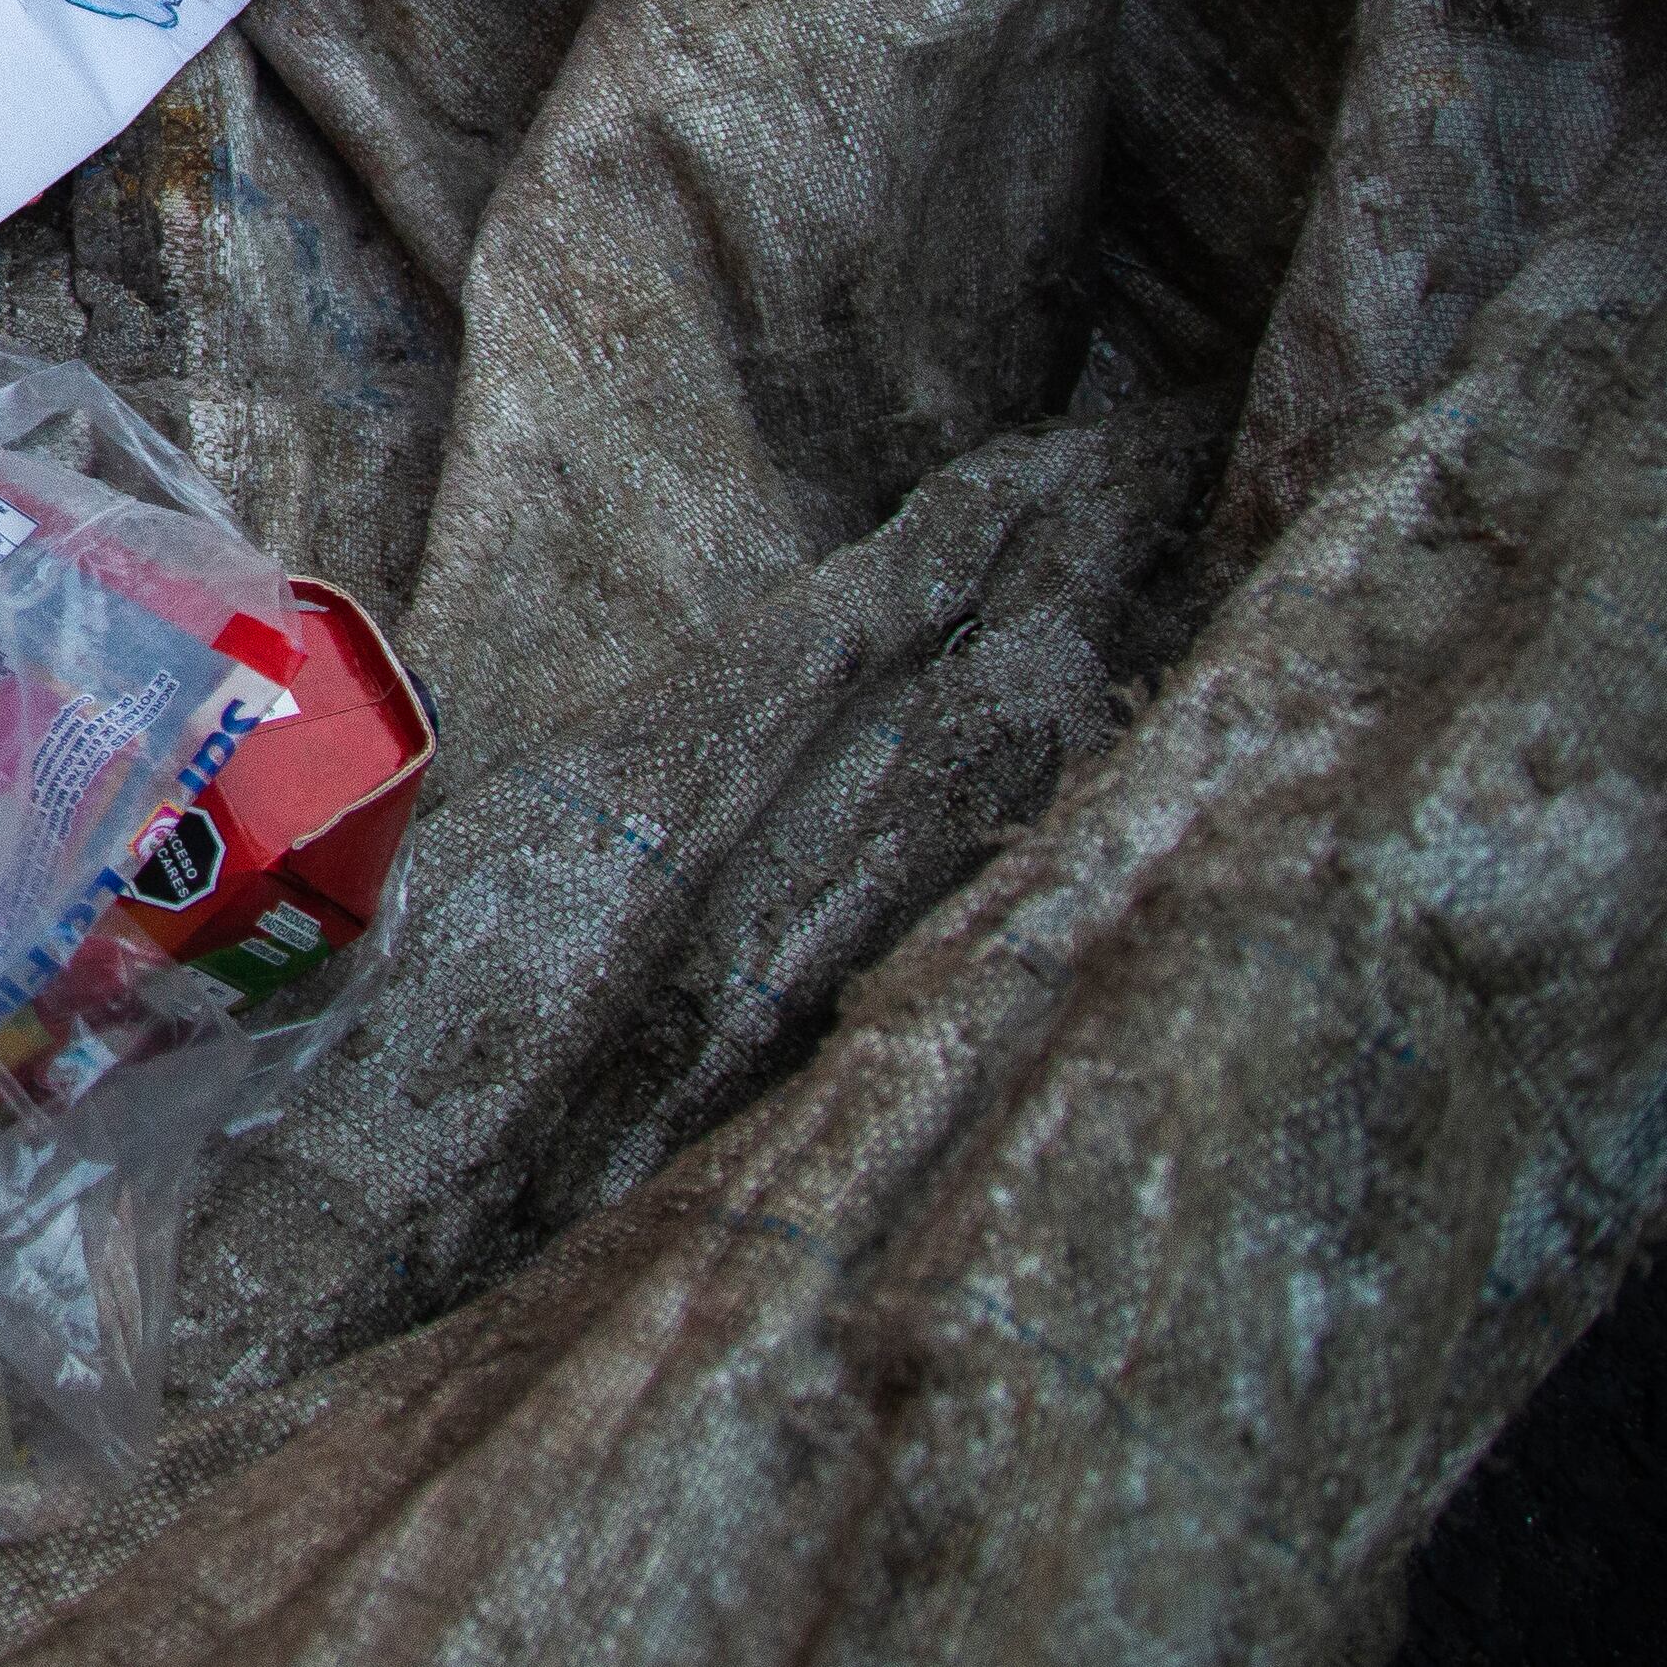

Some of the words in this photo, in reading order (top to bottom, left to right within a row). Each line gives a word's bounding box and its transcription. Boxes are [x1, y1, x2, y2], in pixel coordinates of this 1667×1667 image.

[151, 671, 167, 689] DE
[49, 694, 91, 736] Complejo
[115, 695, 133, 711] DE
[98, 723, 117, 740] DE
[179, 697, 261, 793] Sal
[35, 718, 83, 788] Responsable
[77, 757, 89, 768] A
[82, 737, 102, 758] 612
[39, 734, 87, 809] MILIGRAMOS
[63, 767, 83, 789] 765
[77, 749, 110, 789] Cloruro
[68, 789, 83, 806] de
[166, 830, 200, 881] XCESO
[155, 846, 191, 899] CARES
